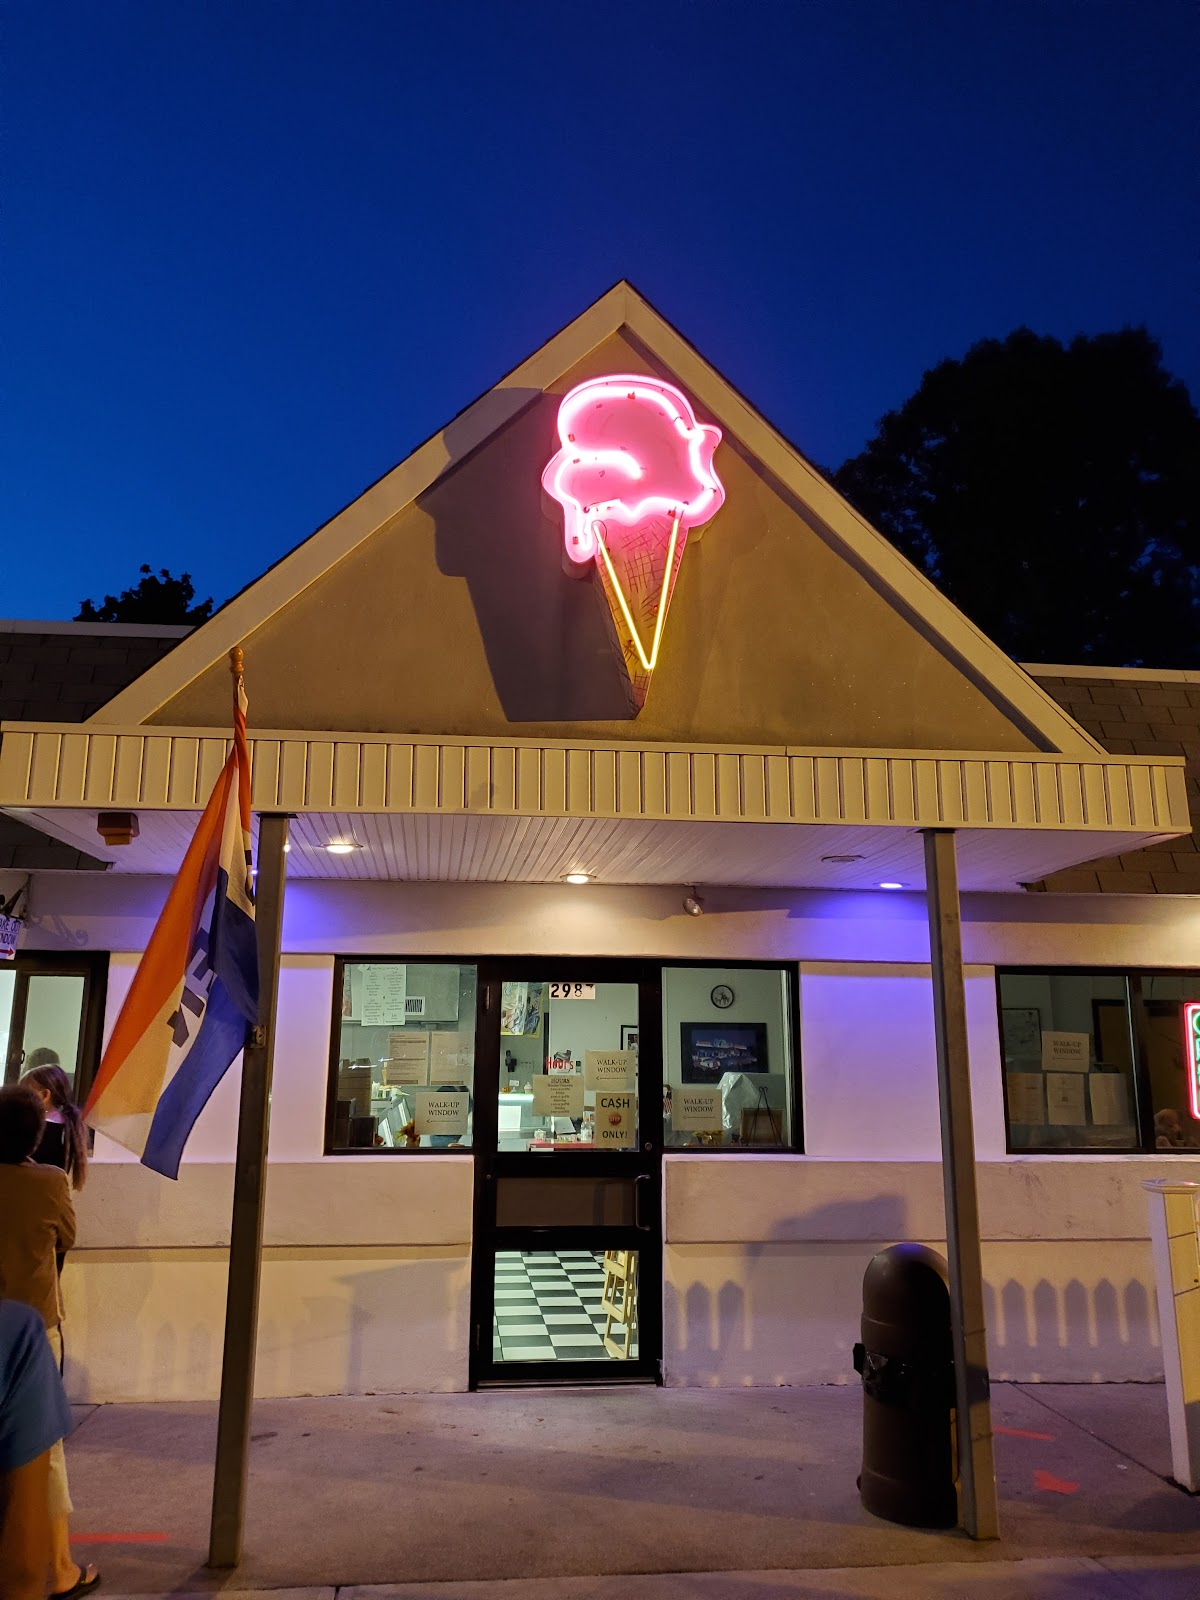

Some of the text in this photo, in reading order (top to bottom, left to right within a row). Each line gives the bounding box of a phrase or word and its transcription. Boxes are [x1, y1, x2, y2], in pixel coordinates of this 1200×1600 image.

[0, 918, 10, 931] AKE
[0, 933, 16, 945] NDOW
[545, 1055, 574, 1070] Hours
[600, 1097, 630, 1109] CA$H
[602, 1130, 628, 1139] ONLY!
